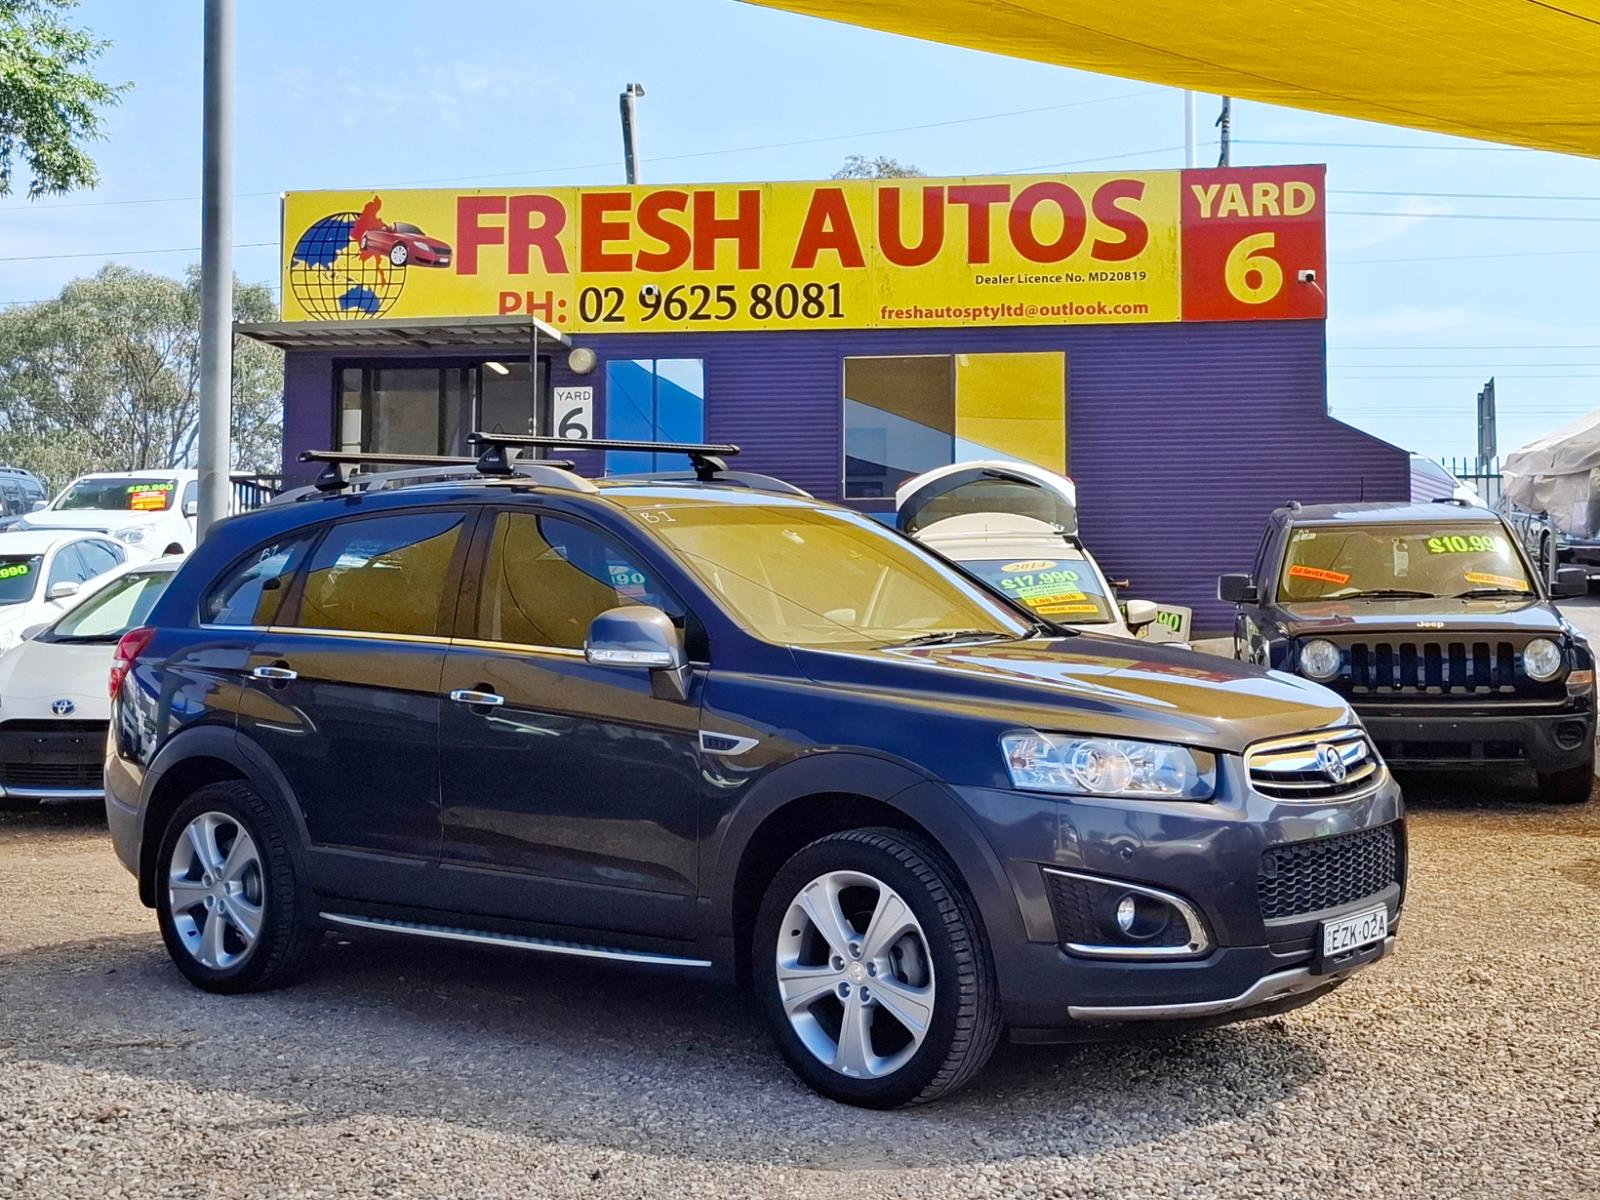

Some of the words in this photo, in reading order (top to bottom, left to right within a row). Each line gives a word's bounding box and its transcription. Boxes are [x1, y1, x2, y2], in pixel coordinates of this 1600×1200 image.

[1191, 181, 1316, 218] YARD
[456, 190, 760, 275] FRESH
[791, 179, 1149, 269] AUTOS
[975, 274, 1015, 285] Dealer
[1018, 273, 1062, 284] Licence
[1065, 272, 1085, 283] No.
[1088, 271, 1147, 282] MD20819
[1225, 232, 1283, 304] 6
[499, 291, 568, 324] PH:
[579, 287, 625, 323] 02
[639, 284, 738, 322] 9625
[749, 282, 845, 320] 8081
[880, 302, 1149, 321] freshautosptyltd@outlook.com
[557, 391, 591, 401] YARD
[558, 406, 588, 440] 6
[1416, 621, 1445, 629] Jeep
